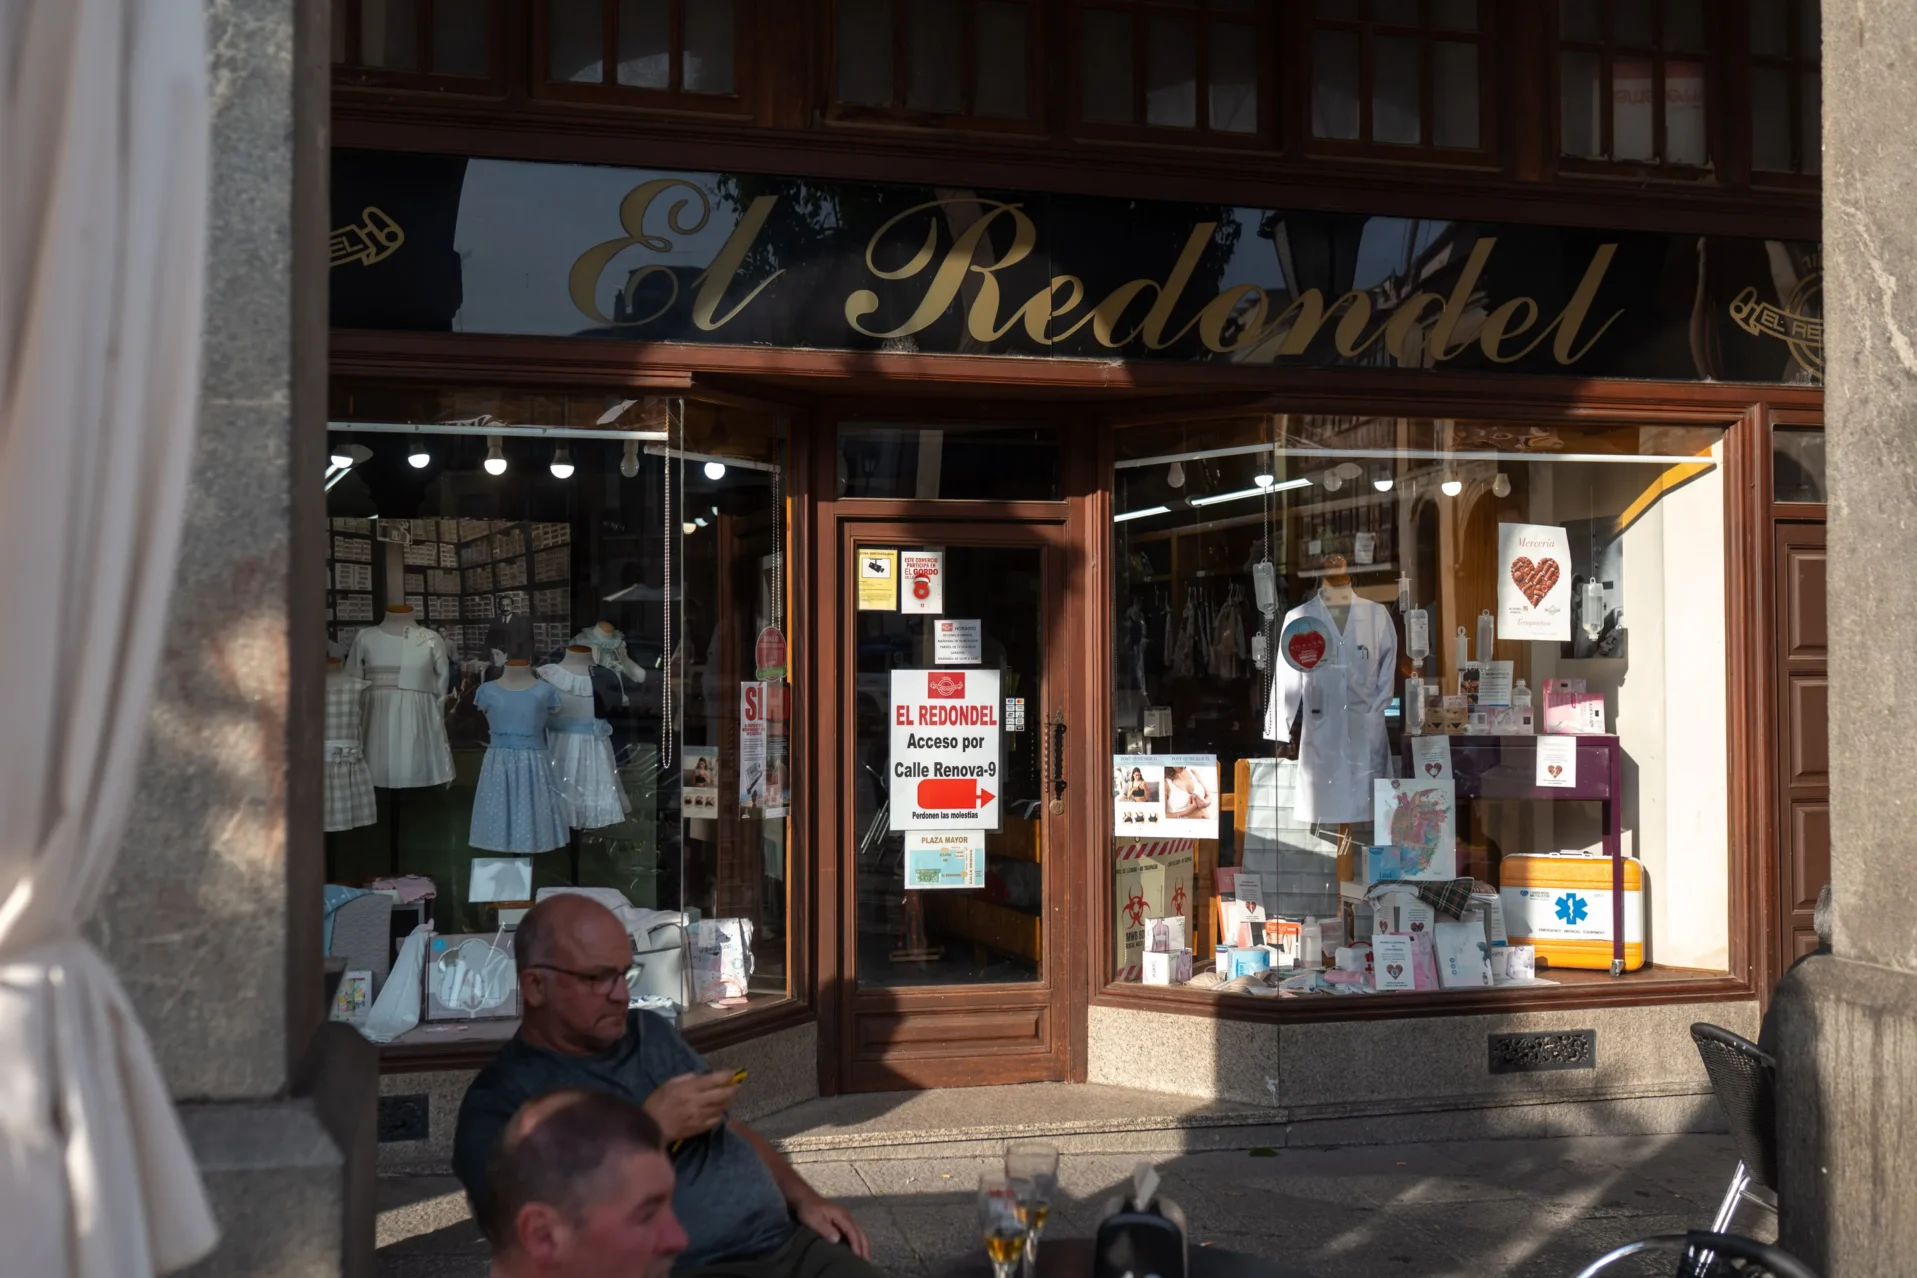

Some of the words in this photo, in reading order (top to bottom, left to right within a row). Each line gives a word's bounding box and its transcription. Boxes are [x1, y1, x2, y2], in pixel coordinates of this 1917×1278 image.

[568, 178, 786, 332] El
[845, 197, 1625, 366] Redondel
[1761, 309, 1786, 332] EL
[1517, 537, 1555, 549] Mercería
[904, 568, 913, 576] EL
[913, 568, 939, 576] GORDO
[744, 681, 763, 721] SÍ
[896, 705, 914, 726] EL
[919, 705, 998, 727] REDONDEL
[907, 733, 958, 749] Acceso
[962, 736, 985, 752] por
[894, 761, 930, 778] Calle
[934, 761, 997, 778] Renova-9
[912, 811, 940, 820] Perdonen
[940, 811, 950, 820] las
[950, 811, 979, 820] molestias
[921, 836, 943, 844] PLAZA
[944, 836, 969, 844] MAYOR
